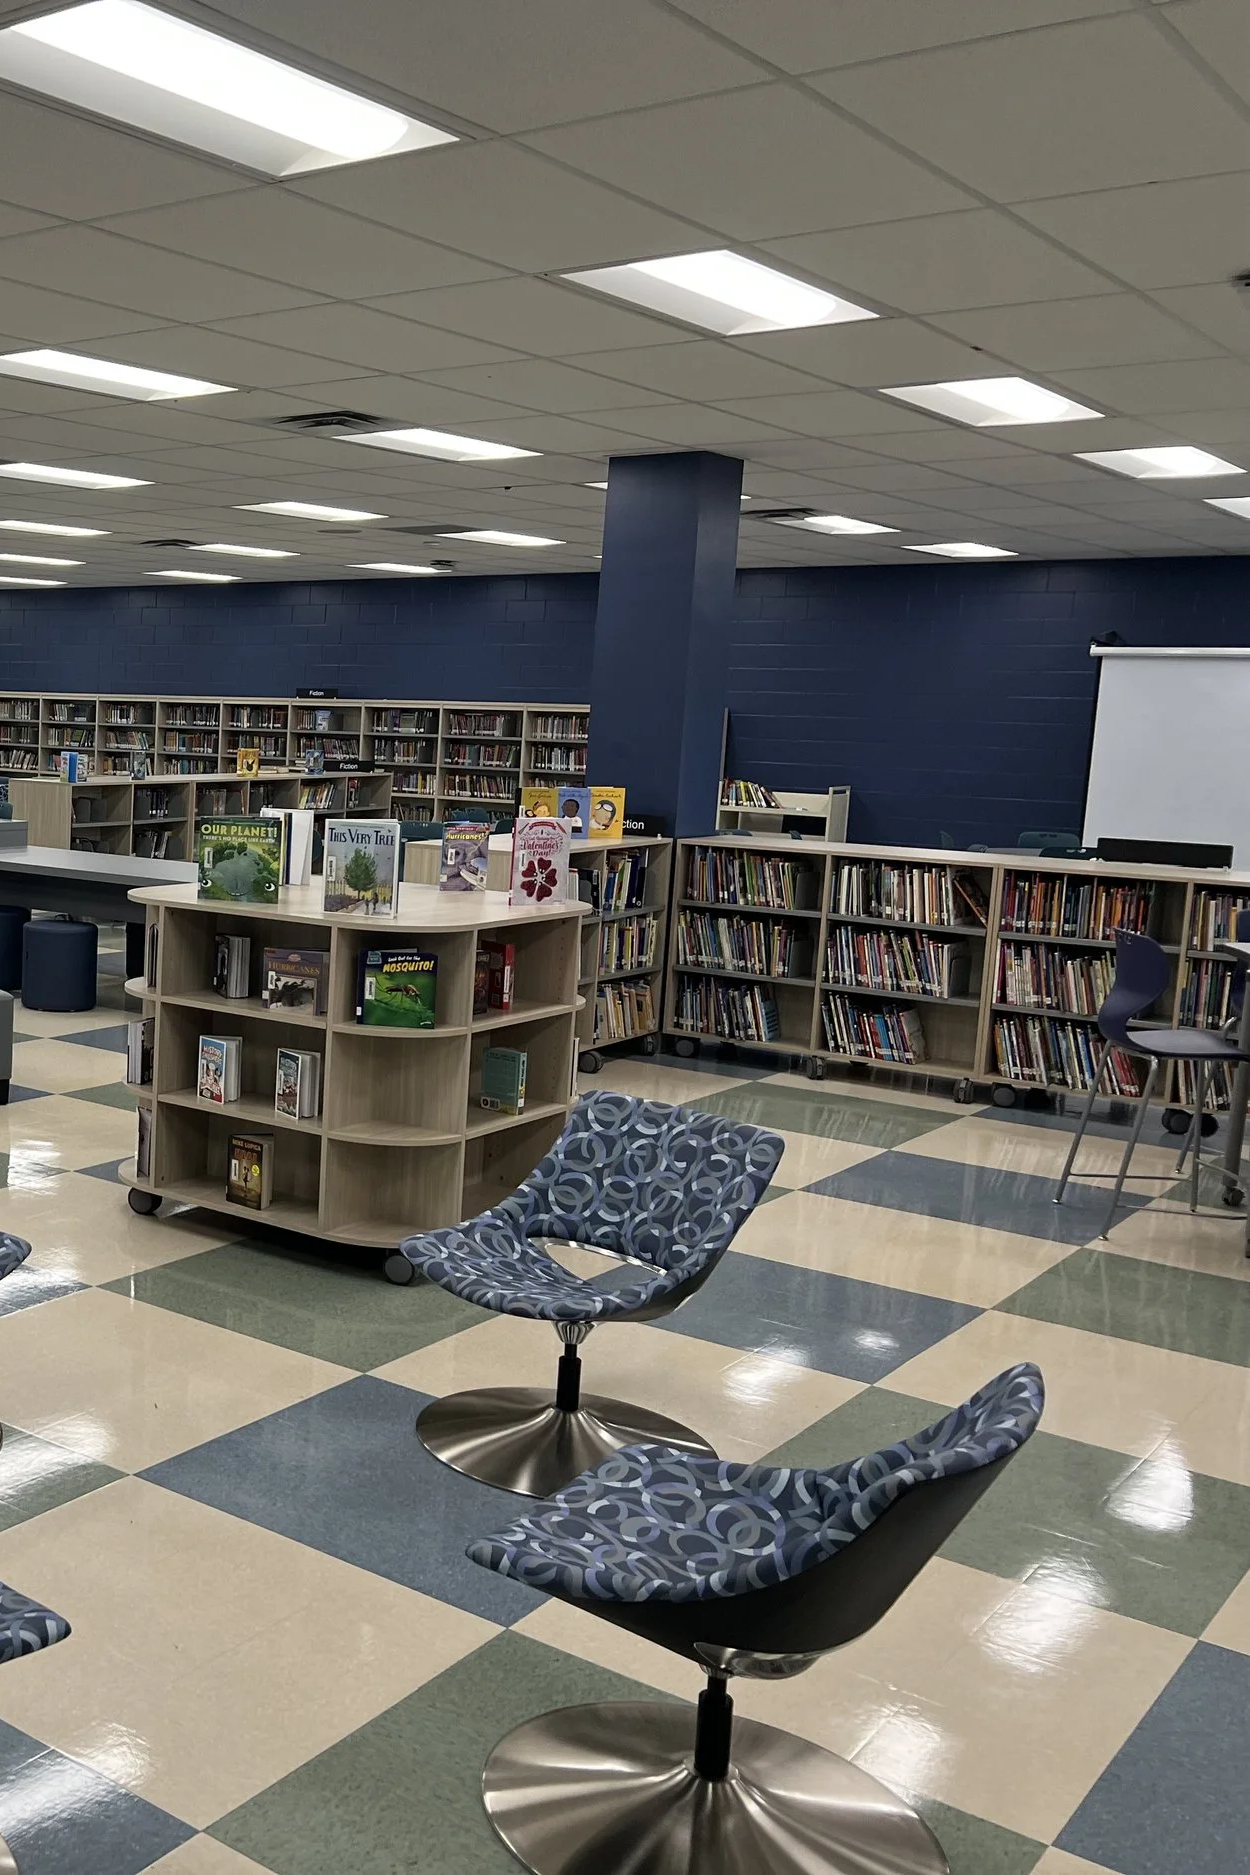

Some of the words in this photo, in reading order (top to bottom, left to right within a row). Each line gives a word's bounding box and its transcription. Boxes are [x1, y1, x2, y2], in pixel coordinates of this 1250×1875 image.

[340, 762, 359, 770] Fiction
[201, 824, 227, 834] OUR
[230, 825, 278, 838] PLANET!
[329, 827, 347, 843] THIS
[348, 828, 372, 845] VERY
[445, 832, 485, 840] Hurricanes!
[269, 961, 320, 975] HURRICANES
[383, 960, 435, 973] MOSQUITO!
